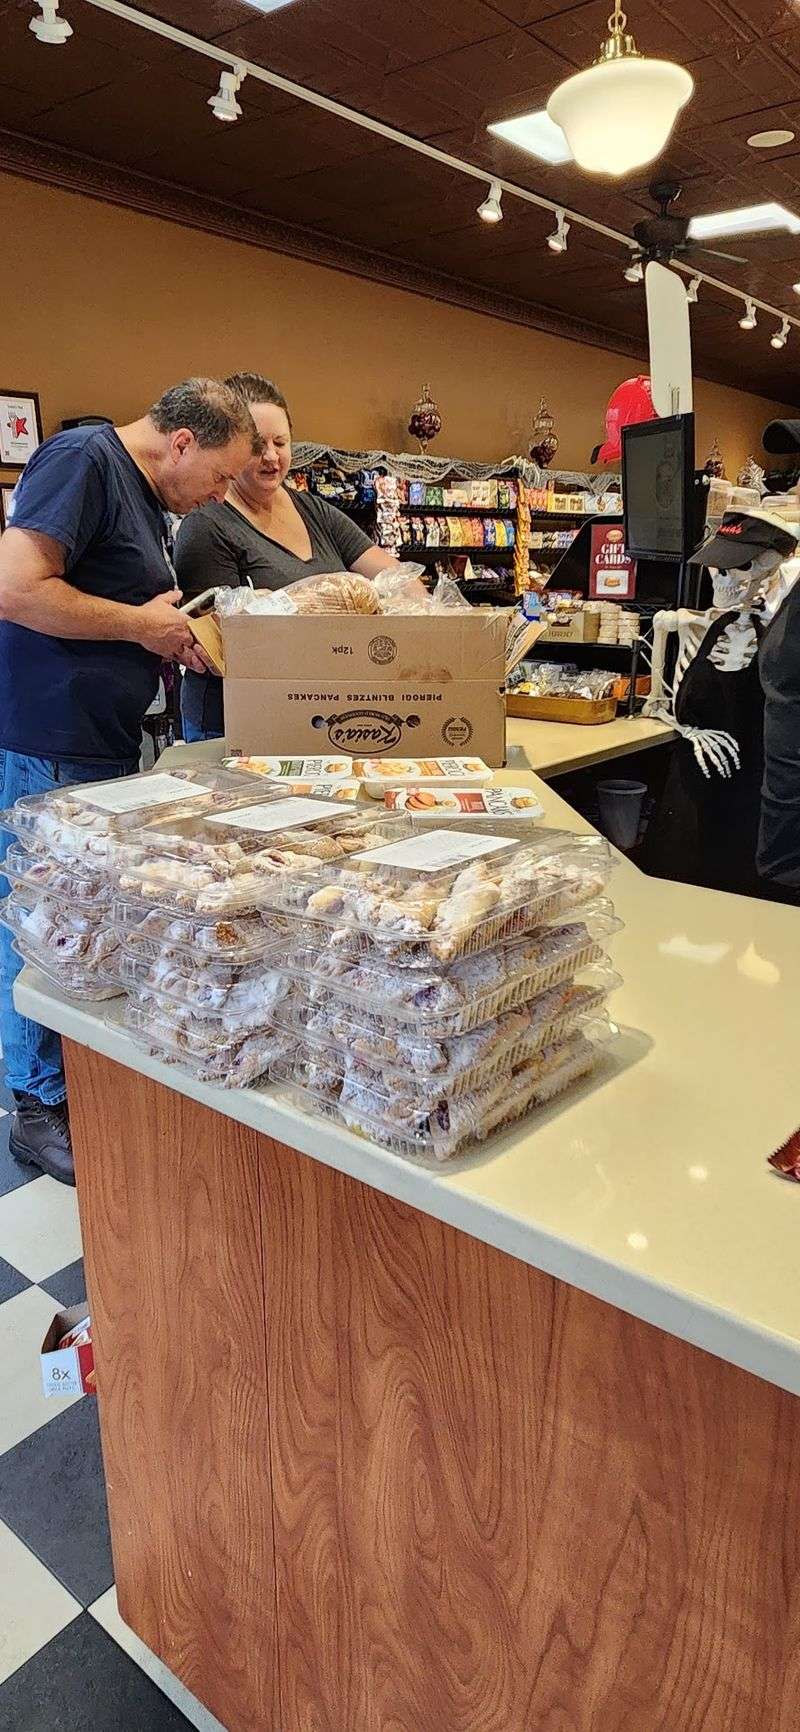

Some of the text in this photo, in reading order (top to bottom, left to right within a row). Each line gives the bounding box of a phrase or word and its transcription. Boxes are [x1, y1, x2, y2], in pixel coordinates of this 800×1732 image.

[595, 553, 632, 565] CARDS
[331, 644, 353, 656] 12pk
[287, 693, 443, 702] PIEROGI BLINTZES PANCAKES
[334, 724, 397, 744] Kasia's
[52, 1367, 71, 1381] 8x
